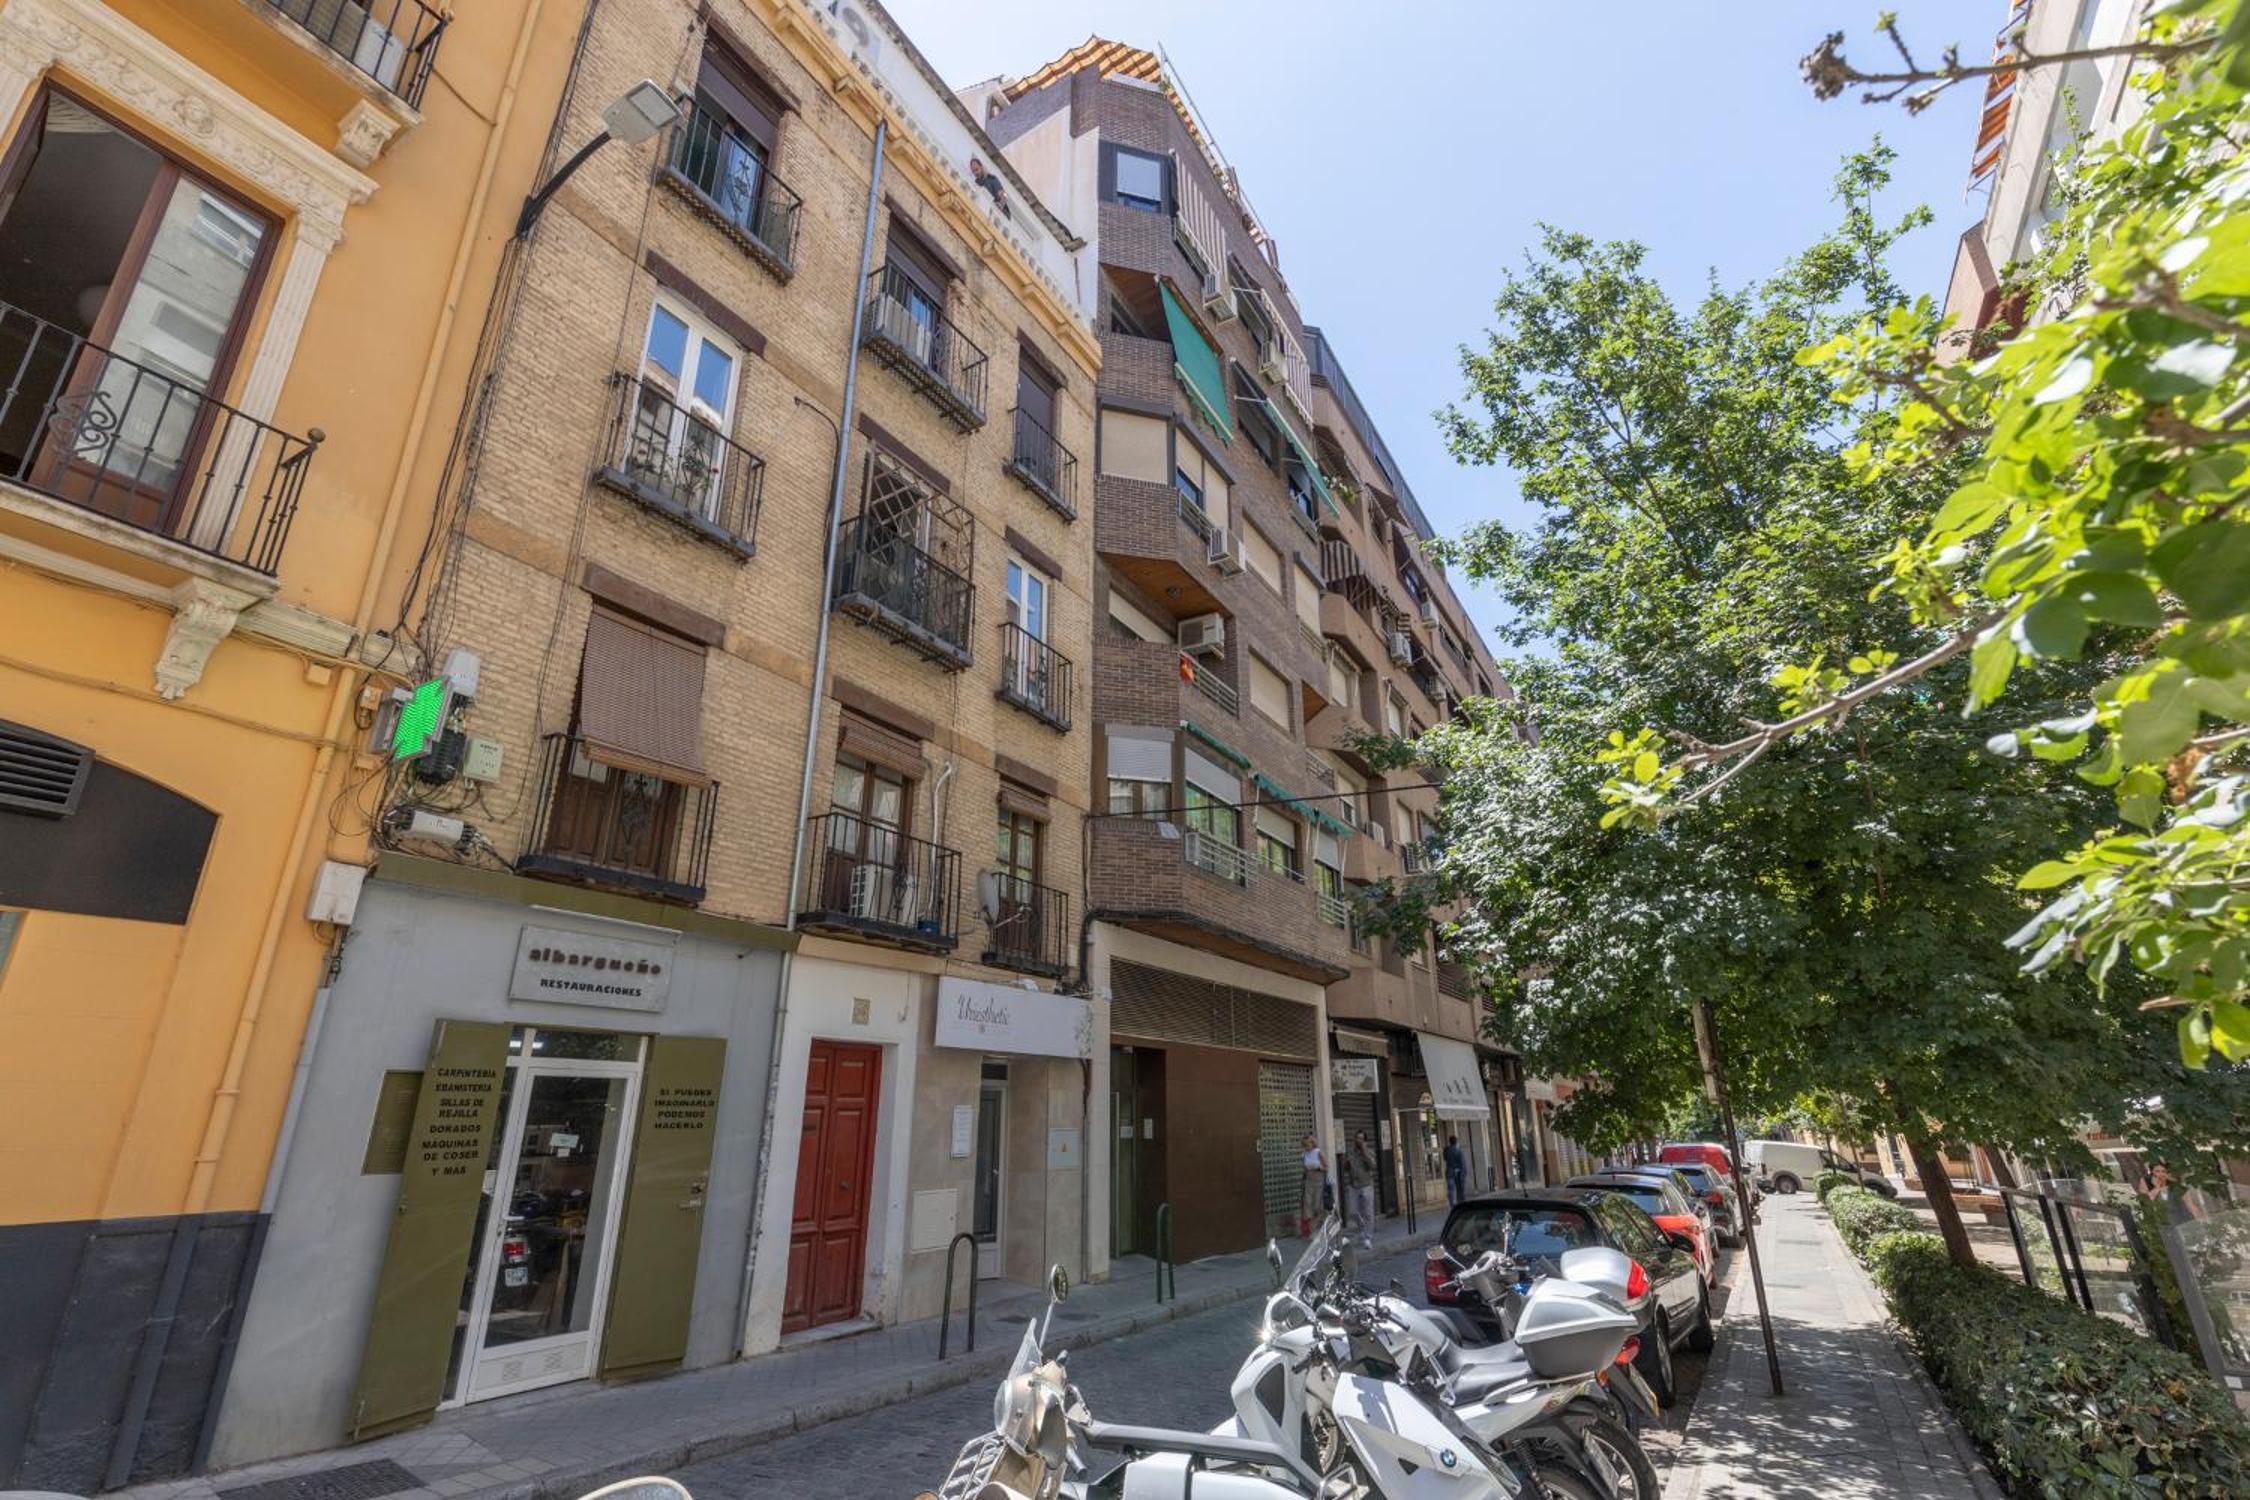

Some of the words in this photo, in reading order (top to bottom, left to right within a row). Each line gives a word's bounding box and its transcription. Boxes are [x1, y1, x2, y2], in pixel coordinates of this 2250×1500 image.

[540, 978, 642, 997] RESTAURACIONES
[440, 1097, 471, 1107] SILLAS
[473, 1097, 485, 1107] DE
[438, 1108, 478, 1119] REJILLA
[658, 1110, 706, 1119] PODEMOS
[430, 1124, 481, 1134] DORADOS
[654, 1122, 704, 1130] HACERLO
[424, 1152, 437, 1162] DE
[443, 1150, 479, 1160] COSER
[432, 1167, 440, 1176] Y
